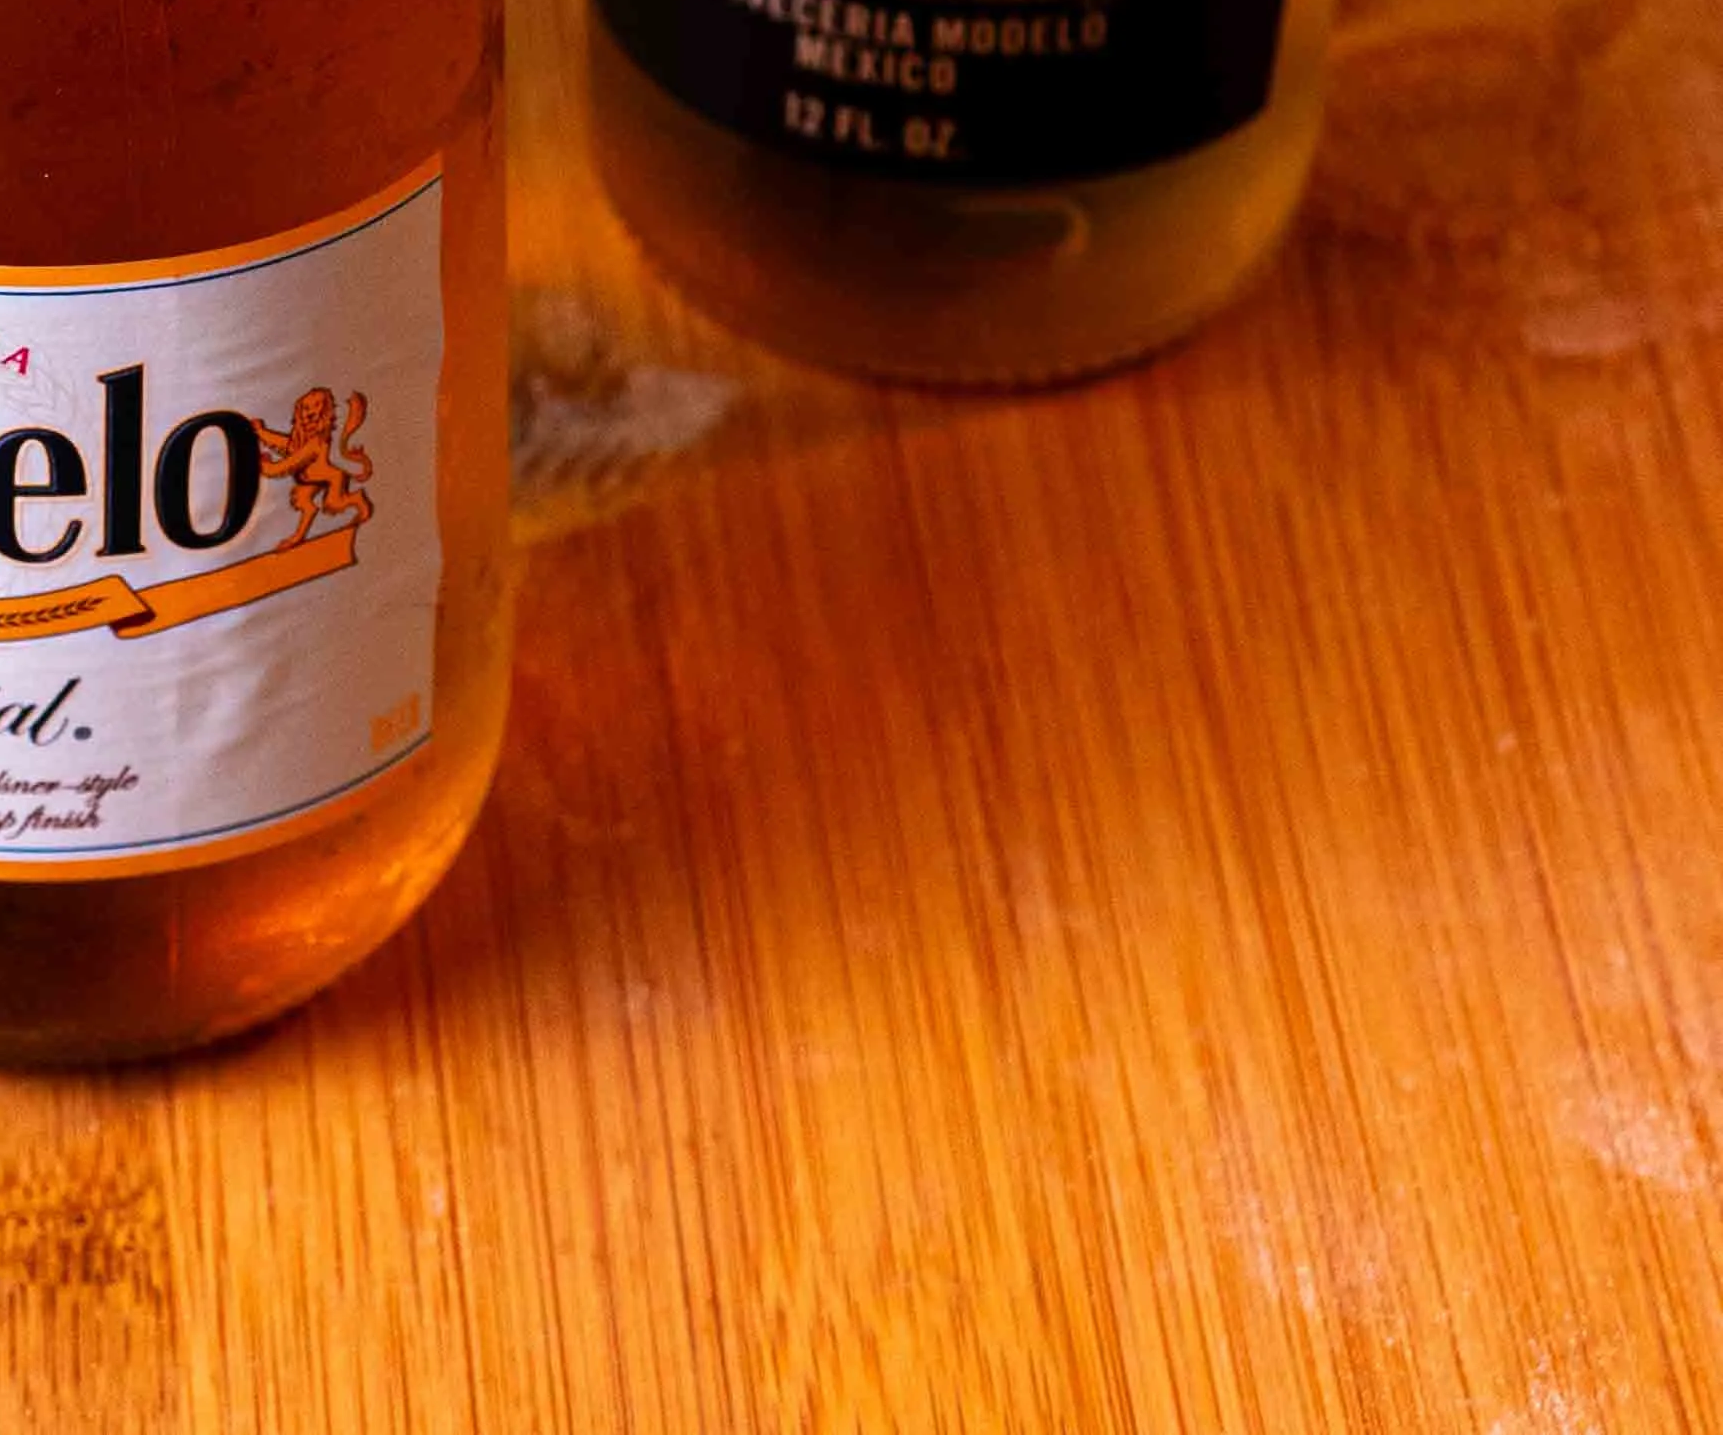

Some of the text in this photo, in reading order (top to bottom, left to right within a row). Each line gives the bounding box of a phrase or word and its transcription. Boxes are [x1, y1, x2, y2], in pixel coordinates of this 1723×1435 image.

[932, 11, 1109, 57] MODELO
[794, 31, 958, 96] MEXICO
[784, 87, 826, 137] 12
[5, 800, 103, 841] finish
